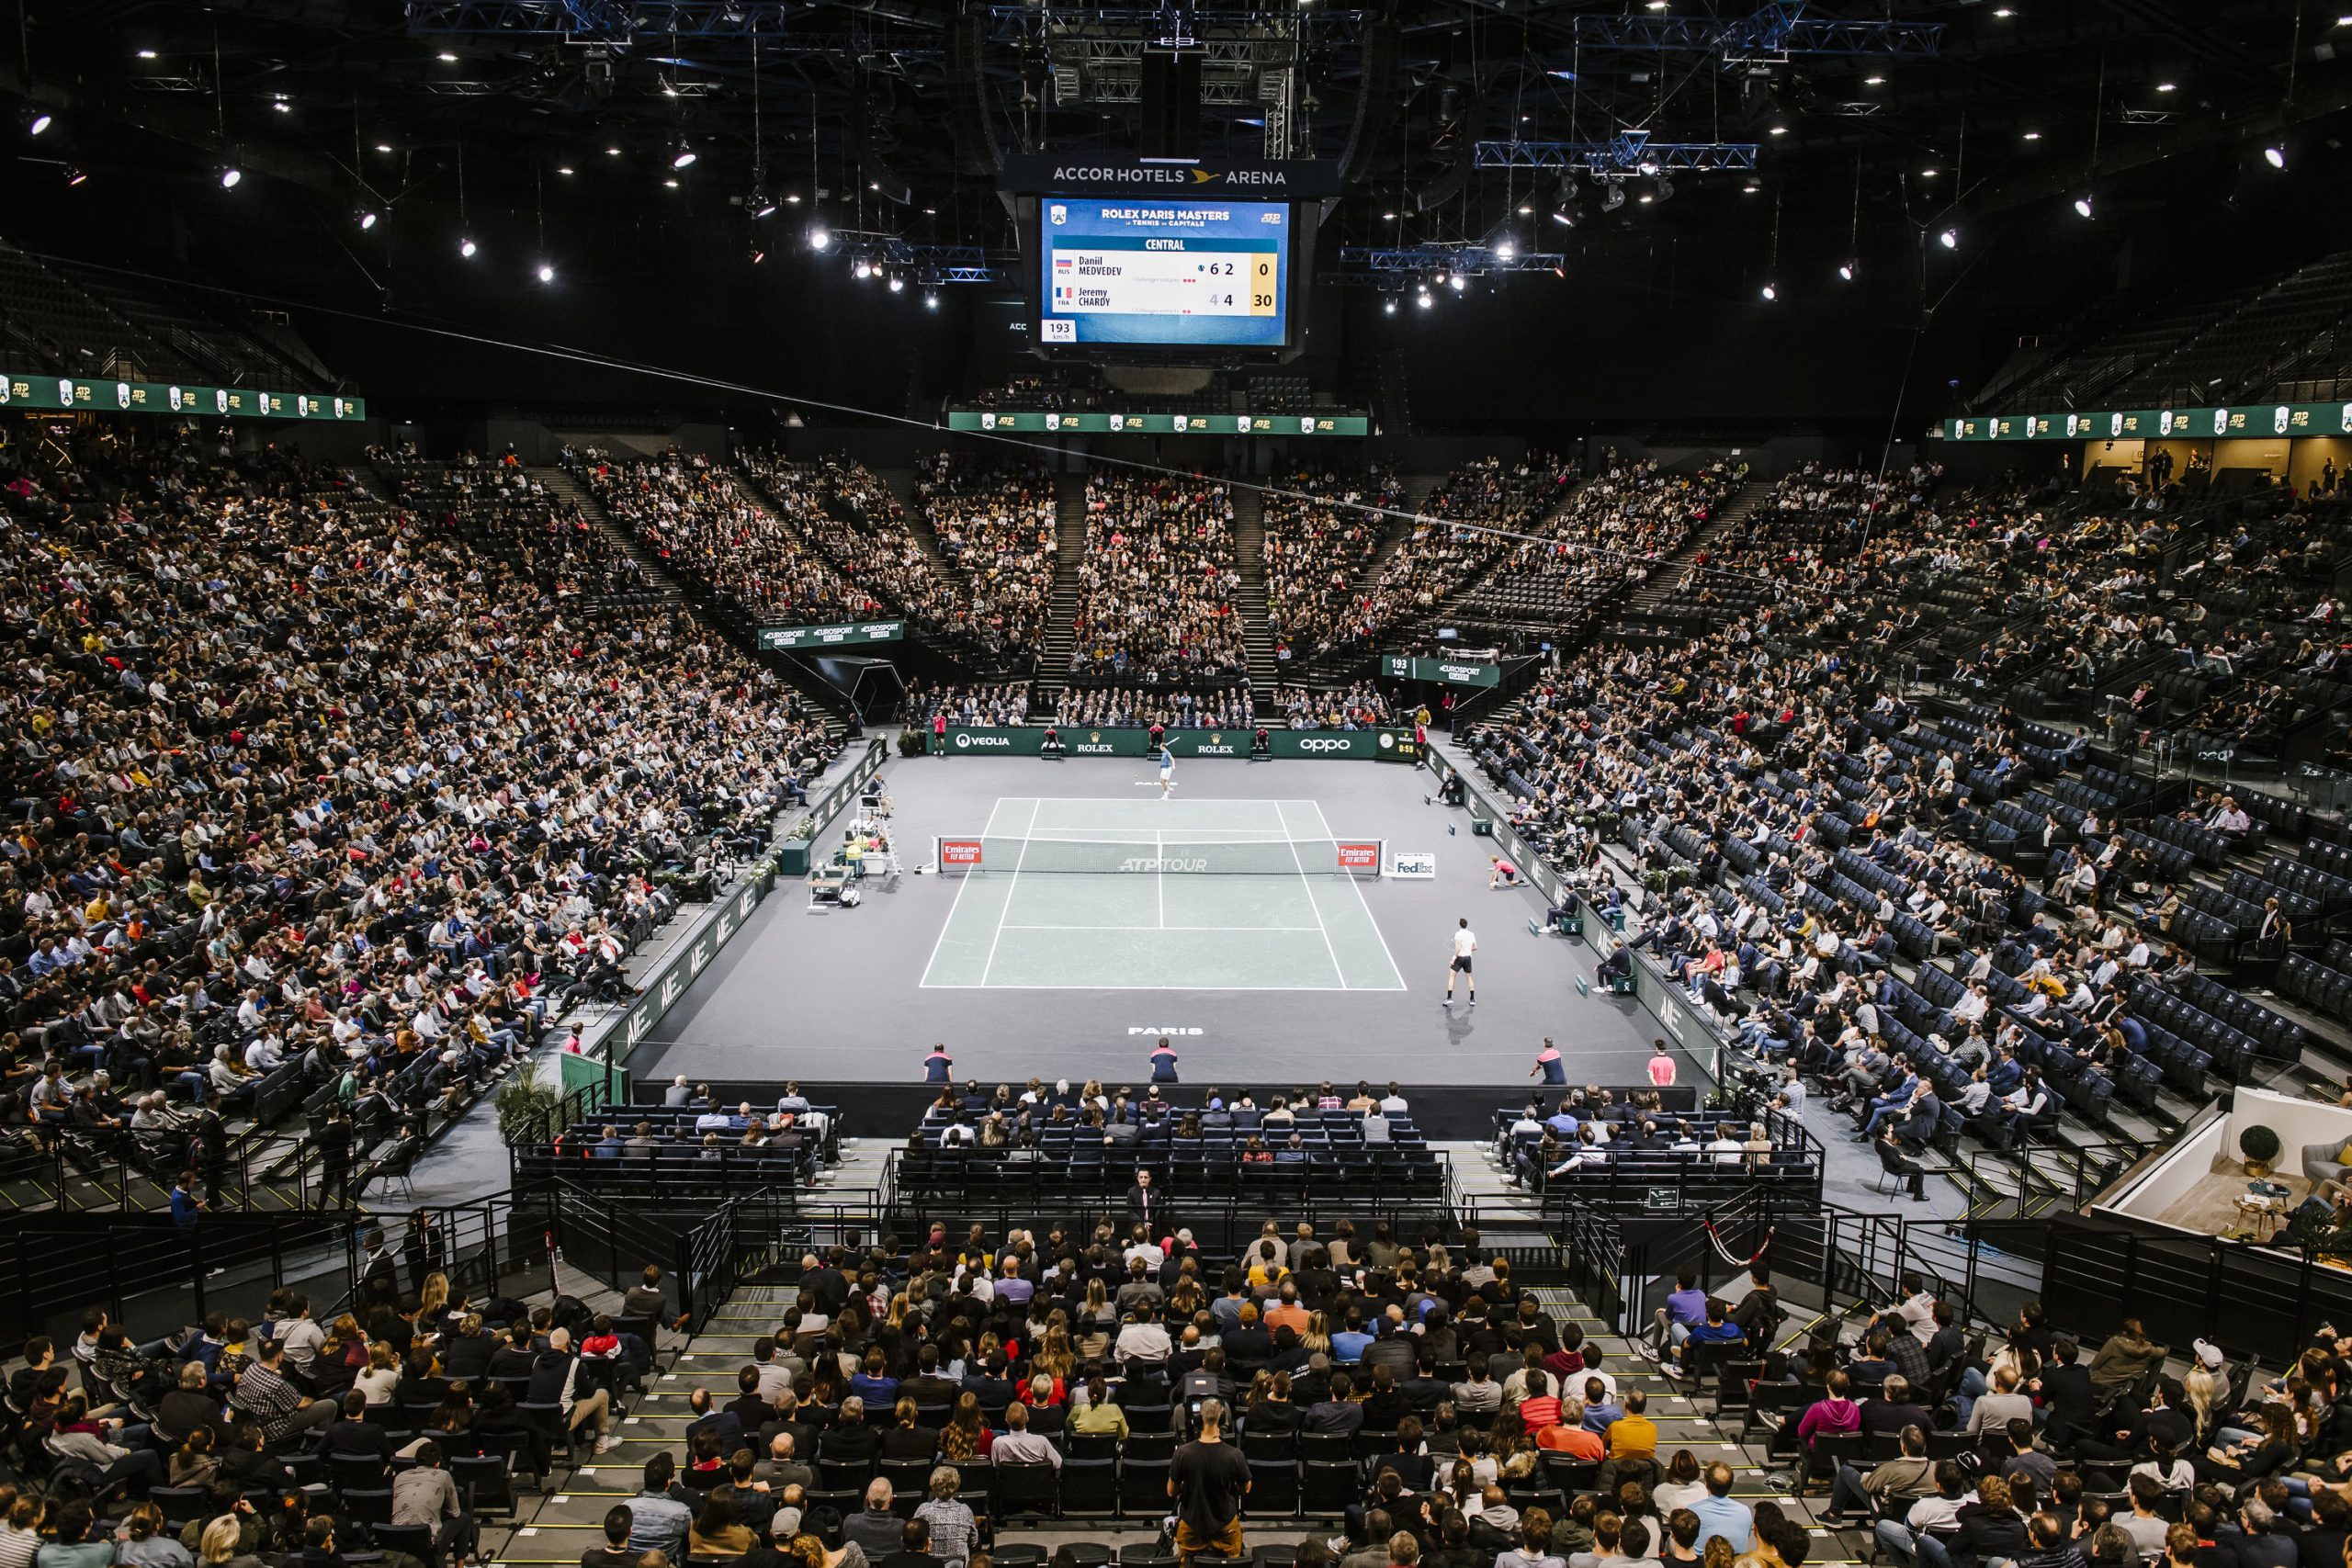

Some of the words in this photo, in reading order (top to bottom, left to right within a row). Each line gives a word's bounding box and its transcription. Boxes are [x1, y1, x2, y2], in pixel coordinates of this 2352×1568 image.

[1226, 171, 1286, 185] ARENA
[1102, 209, 1139, 220] ROLEX
[1141, 209, 1175, 220] PARIS
[1177, 210, 1230, 221] MASTERS
[1145, 239, 1185, 251] CENTRAL
[1079, 256, 1102, 265] Daniil
[1079, 266, 1122, 276] MEDVEDEV
[1210, 263, 1219, 276] 6
[1225, 263, 1234, 276] 2
[1259, 263, 1269, 276] 0
[1079, 288, 1108, 299] Jeremy
[1079, 298, 1111, 307] CHARDY
[1209, 294, 1218, 306] 4
[1224, 294, 1233, 306] 4
[1254, 294, 1272, 307] 30
[1049, 323, 1069, 333] 193
[815, 626, 854, 636] EUROSPORT
[862, 624, 899, 632] EUROSPORT
[765, 630, 806, 638] EUROSPORT
[1392, 659, 1408, 669] 193
[1441, 665, 1480, 675] EUROSPORT
[971, 737, 1010, 746] VEOLIA
[1300, 739, 1351, 752] oppo
[1077, 744, 1114, 752] ROLEX
[1198, 745, 1234, 753] ROLEX
[1398, 745, 1413, 753] 0:59
[944, 845, 979, 853] Emirates
[1340, 849, 1374, 857] Emirates
[1117, 858, 1158, 871] ATP
[1161, 859, 1207, 872] TOUR
[1397, 863, 1432, 873] FedEx
[1127, 1027, 1204, 1035] PARIS
